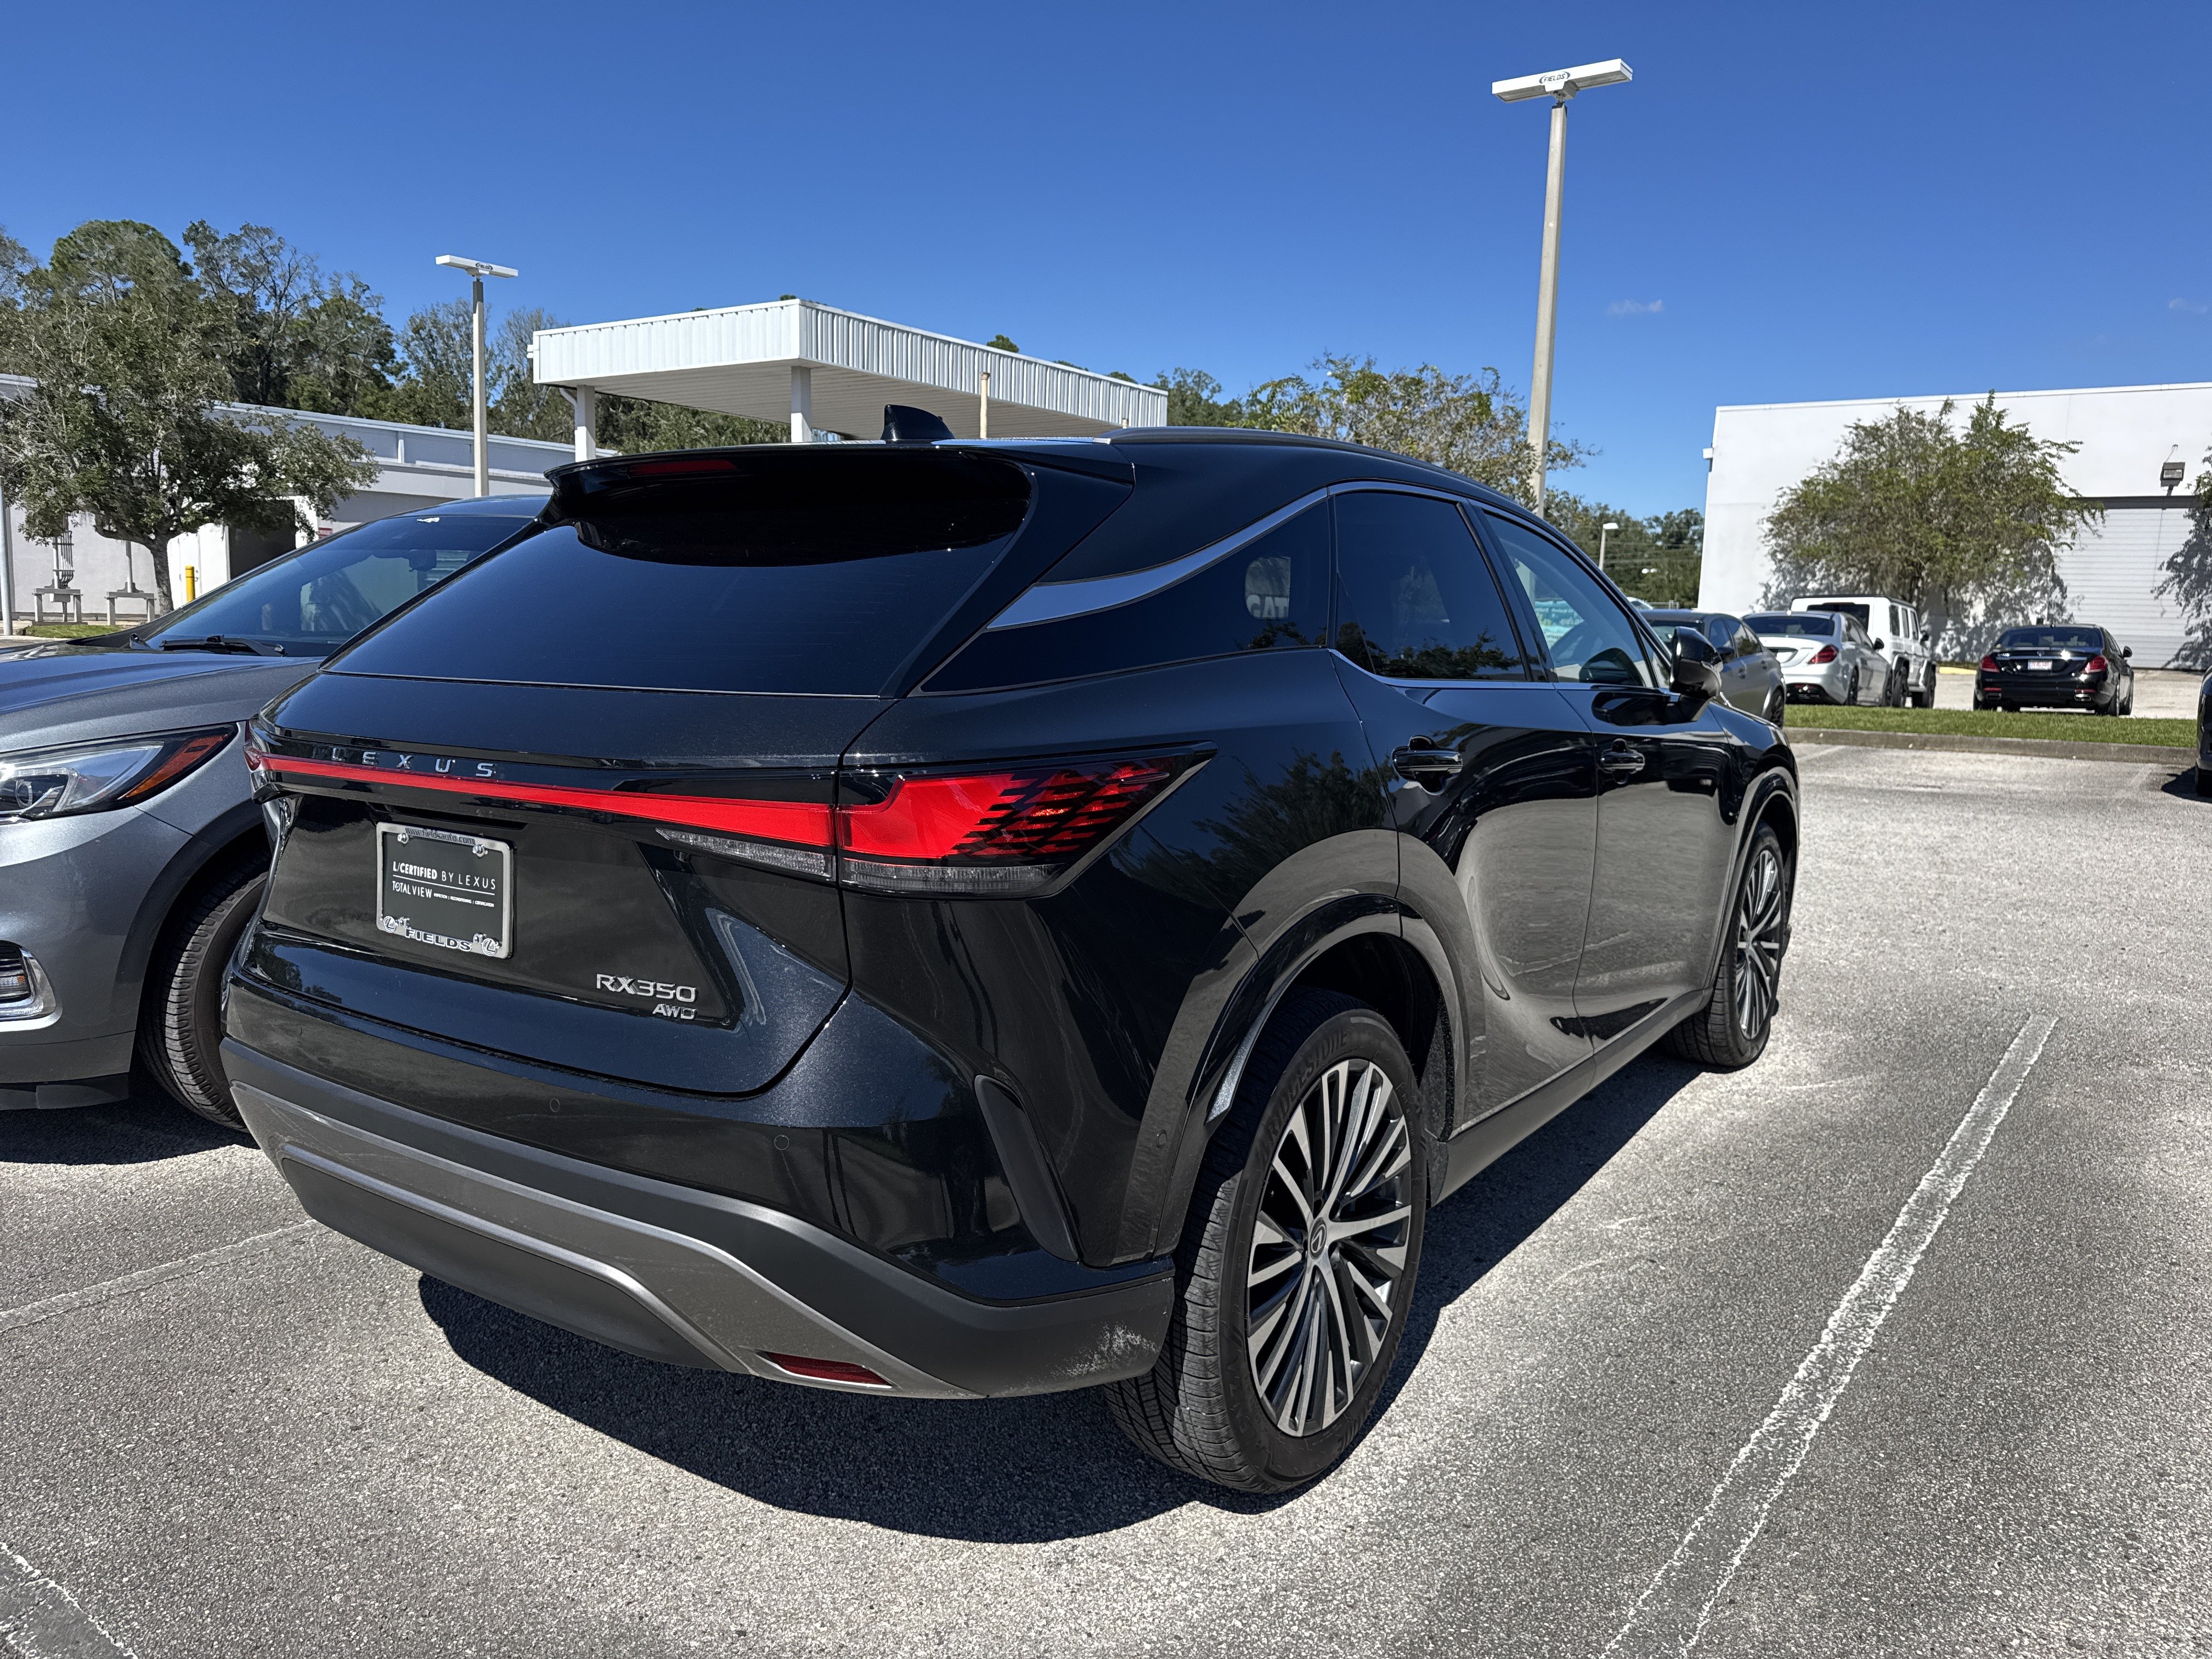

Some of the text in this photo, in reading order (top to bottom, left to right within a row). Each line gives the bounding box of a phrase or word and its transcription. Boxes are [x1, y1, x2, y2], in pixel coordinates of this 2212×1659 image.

[1543, 73, 1566, 82] FIELDS
[331, 747, 495, 777] LEXUS
[393, 861, 495, 890] L/CERTIFIED BY LEXUS
[411, 885, 432, 899] VIEW
[405, 927, 472, 952] FIELDS
[652, 1003, 697, 1020] AWD
